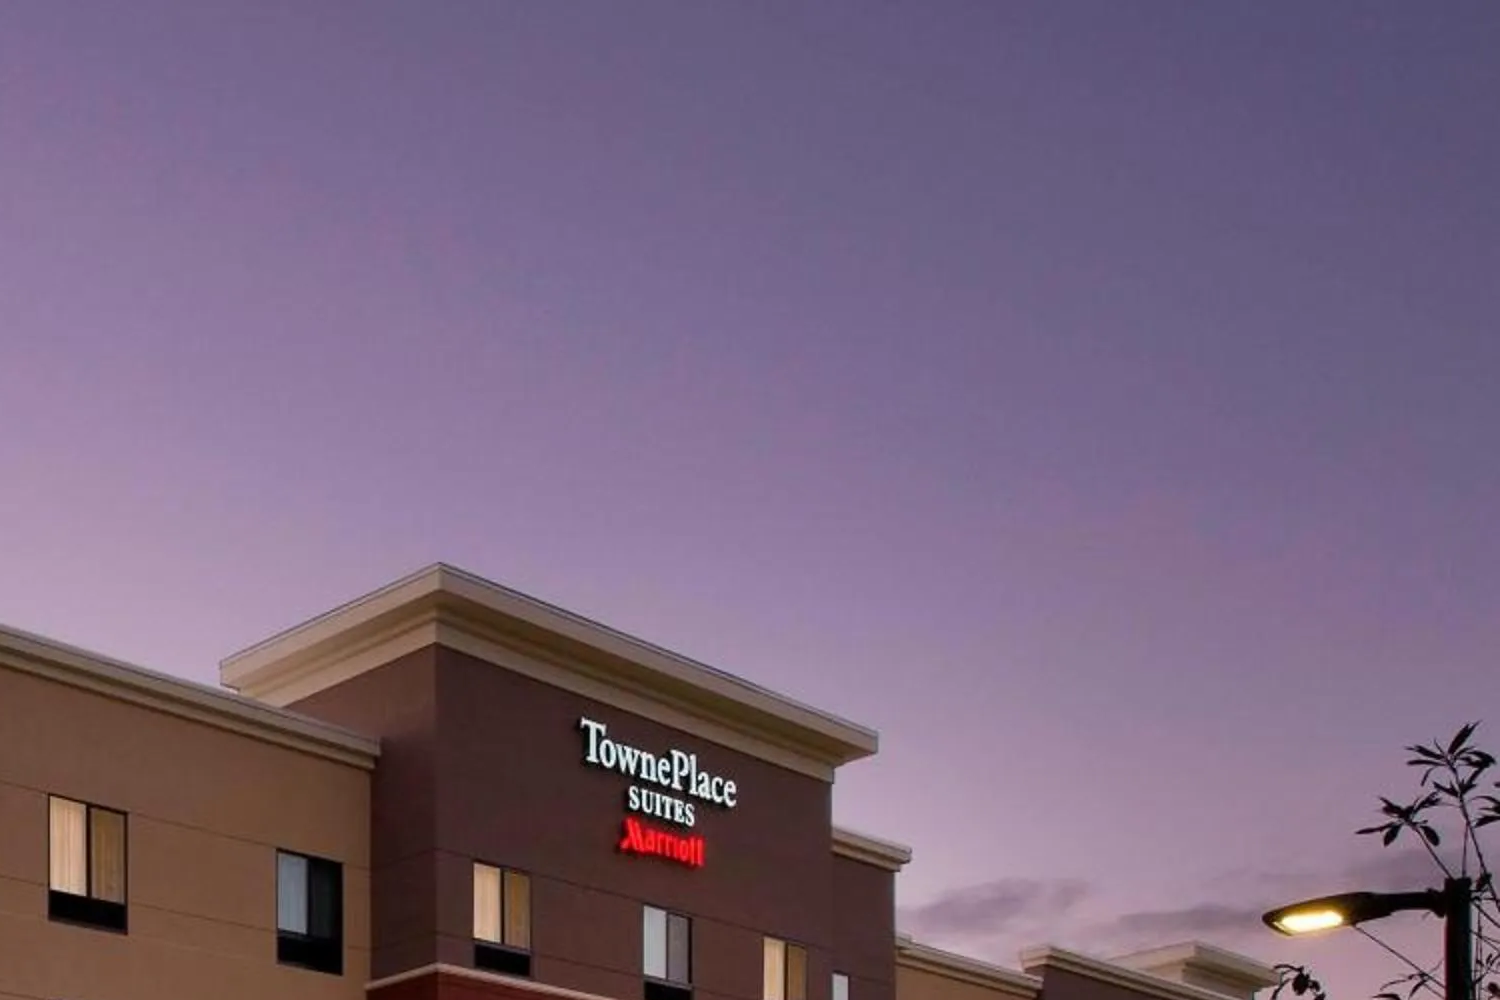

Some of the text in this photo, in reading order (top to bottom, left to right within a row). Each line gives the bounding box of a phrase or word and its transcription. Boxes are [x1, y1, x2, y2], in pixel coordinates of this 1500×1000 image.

[580, 716, 738, 808] TownePlace
[628, 785, 696, 827] SUITES
[619, 817, 705, 868] Marriott
